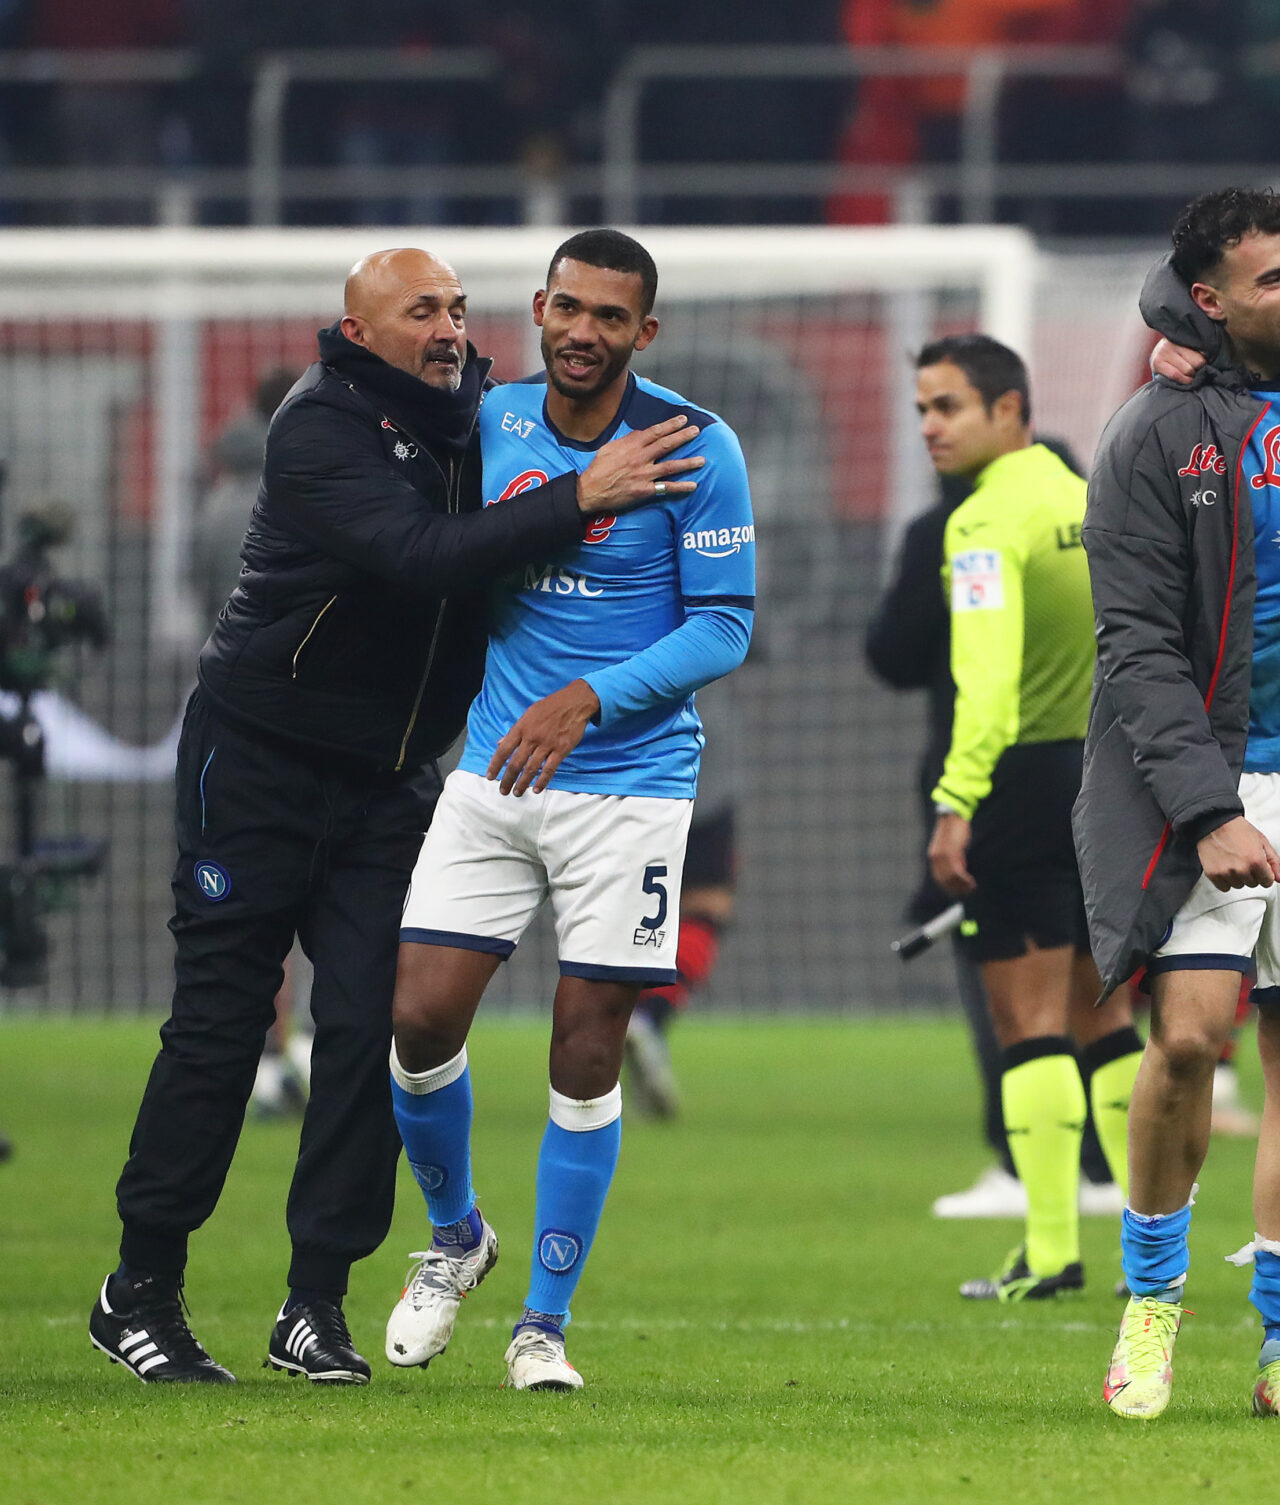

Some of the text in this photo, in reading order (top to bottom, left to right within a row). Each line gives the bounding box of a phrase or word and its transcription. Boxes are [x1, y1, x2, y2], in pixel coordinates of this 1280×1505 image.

[501, 411, 537, 439] EA7
[202, 870, 219, 893] N
[640, 865, 668, 930] 5
[633, 928, 666, 951] EA7
[545, 1239, 572, 1265] N
